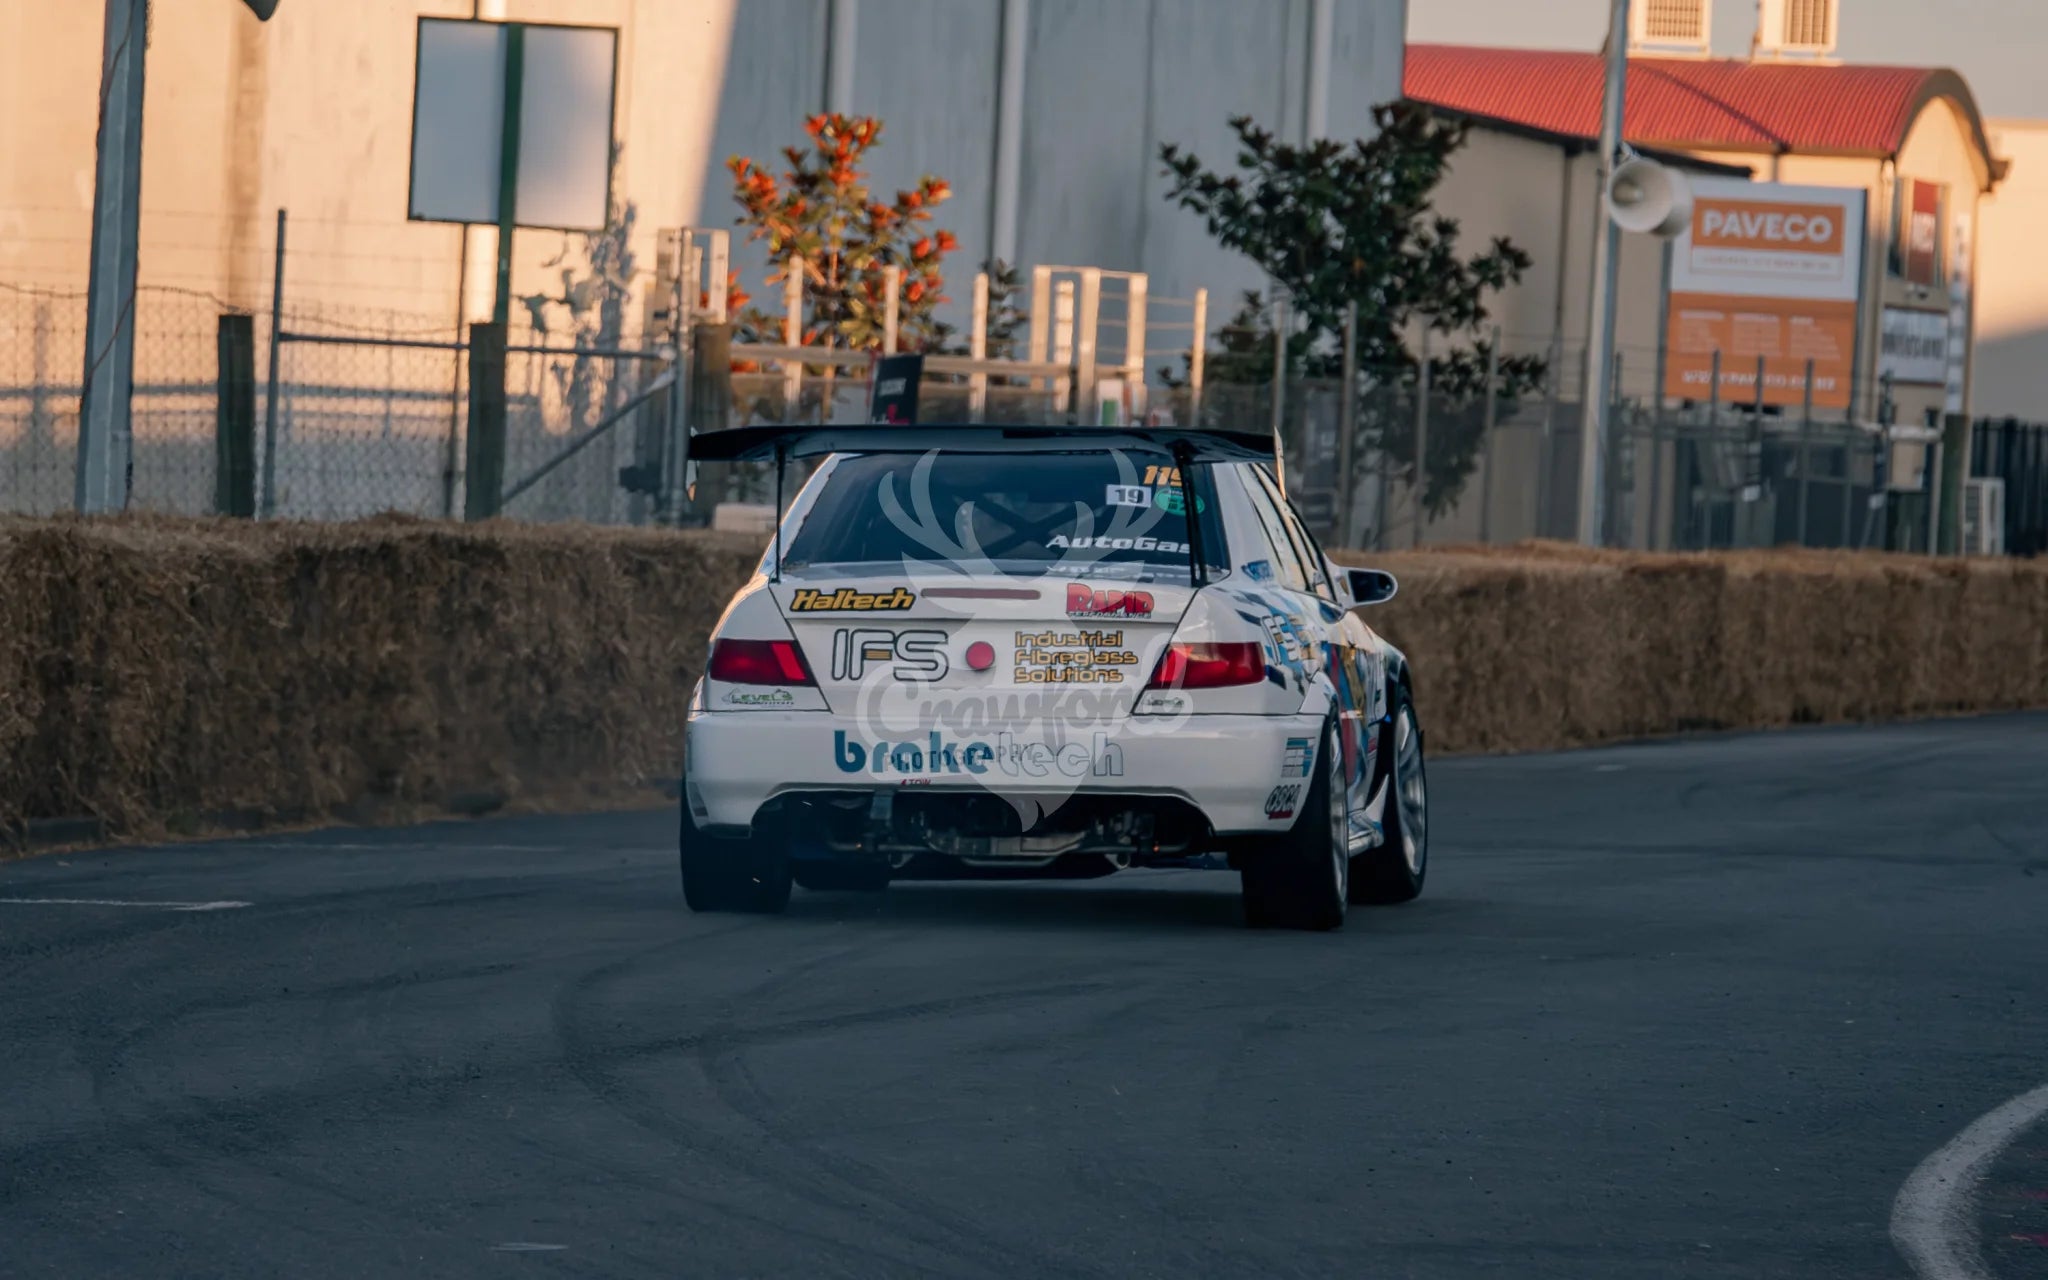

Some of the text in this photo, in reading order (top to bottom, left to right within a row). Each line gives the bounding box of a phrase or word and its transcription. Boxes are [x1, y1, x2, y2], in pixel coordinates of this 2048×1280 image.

[1702, 209, 1833, 243] PAVECO
[1114, 488, 1144, 504] 19
[790, 587, 916, 612] Haltech
[1015, 630, 1123, 648] Industrial
[832, 628, 949, 683] IFS
[1015, 649, 1139, 668] Fibreglass
[1014, 667, 1124, 683] Solutions
